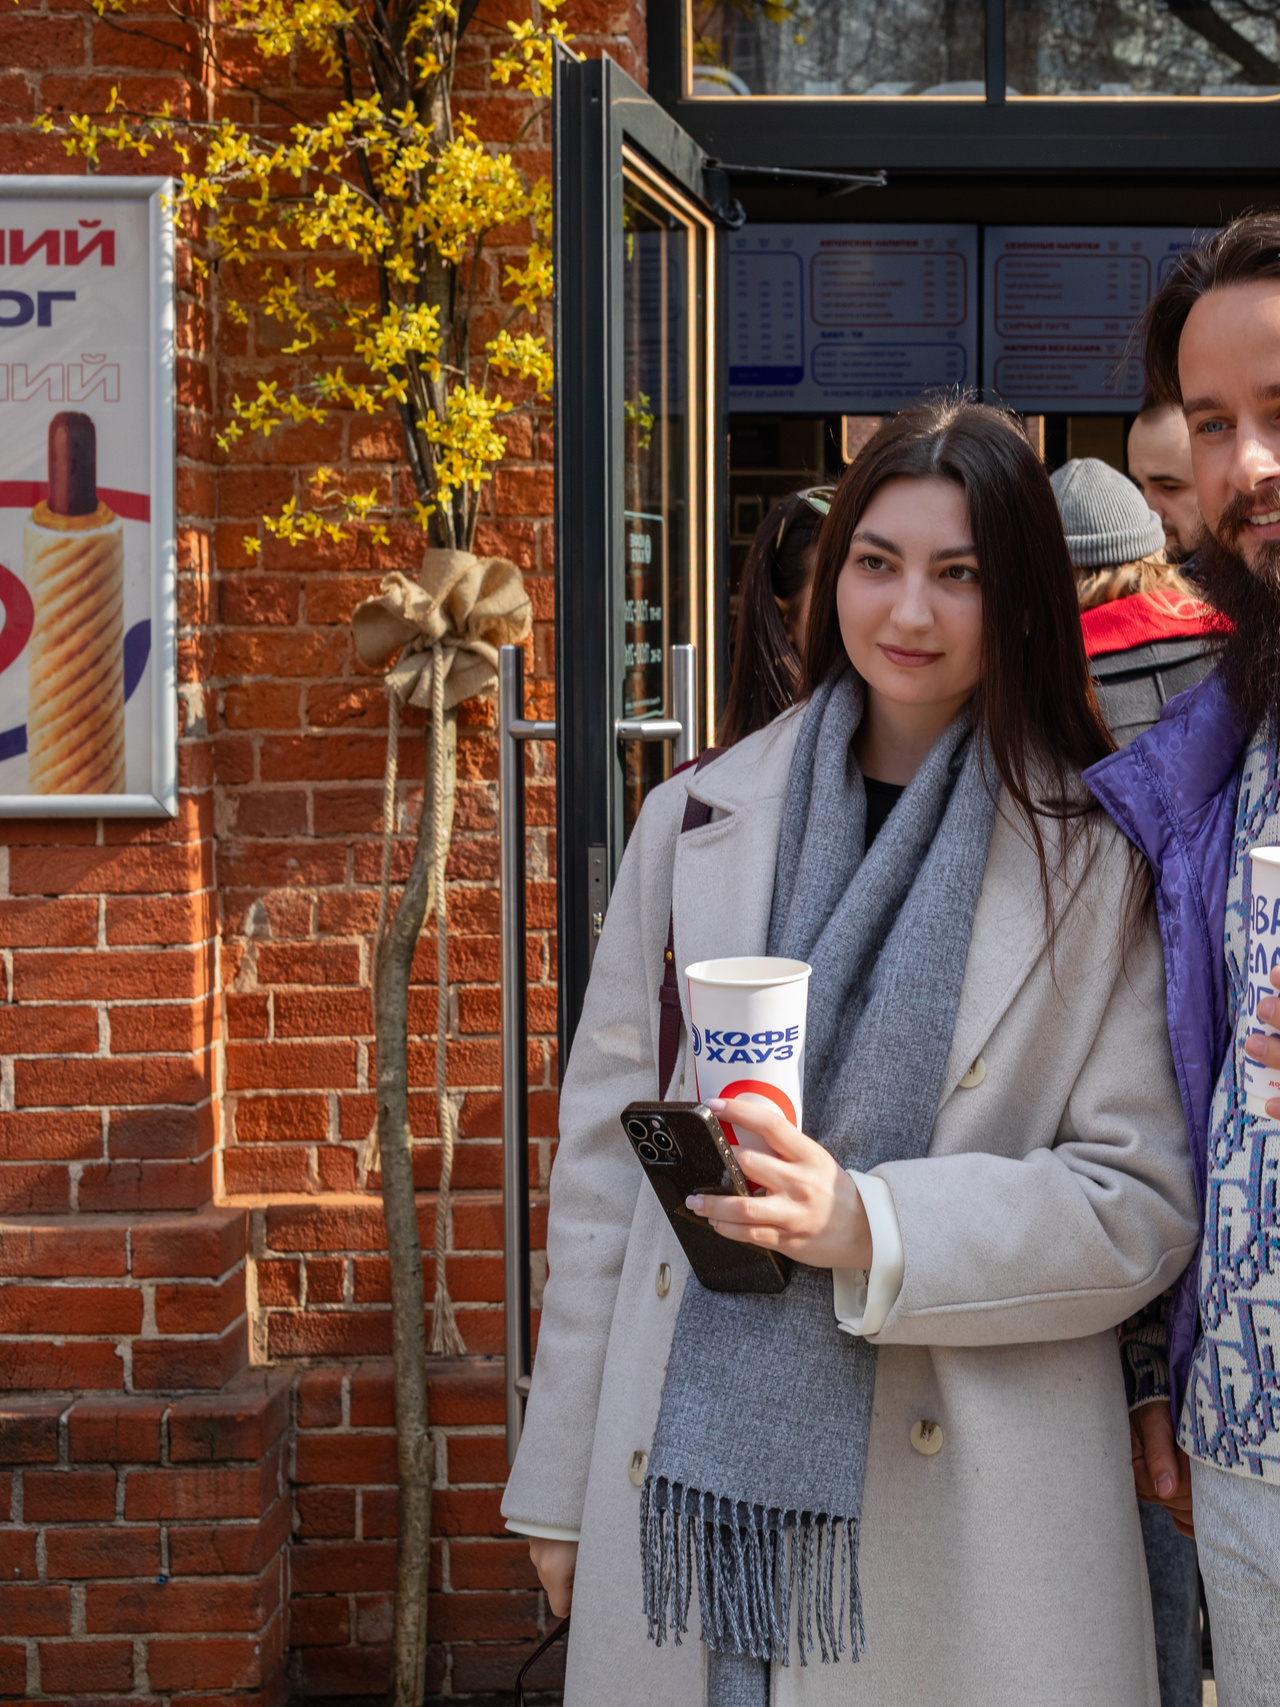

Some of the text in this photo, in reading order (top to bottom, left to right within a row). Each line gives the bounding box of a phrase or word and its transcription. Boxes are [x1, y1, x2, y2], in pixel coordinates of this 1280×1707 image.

[0, 219, 115, 266] ИЙ
[0, 353, 120, 402] ИЙ
[705, 1025, 799, 1047] КОФЕ
[706, 1044, 793, 1064] ХАУЗ
